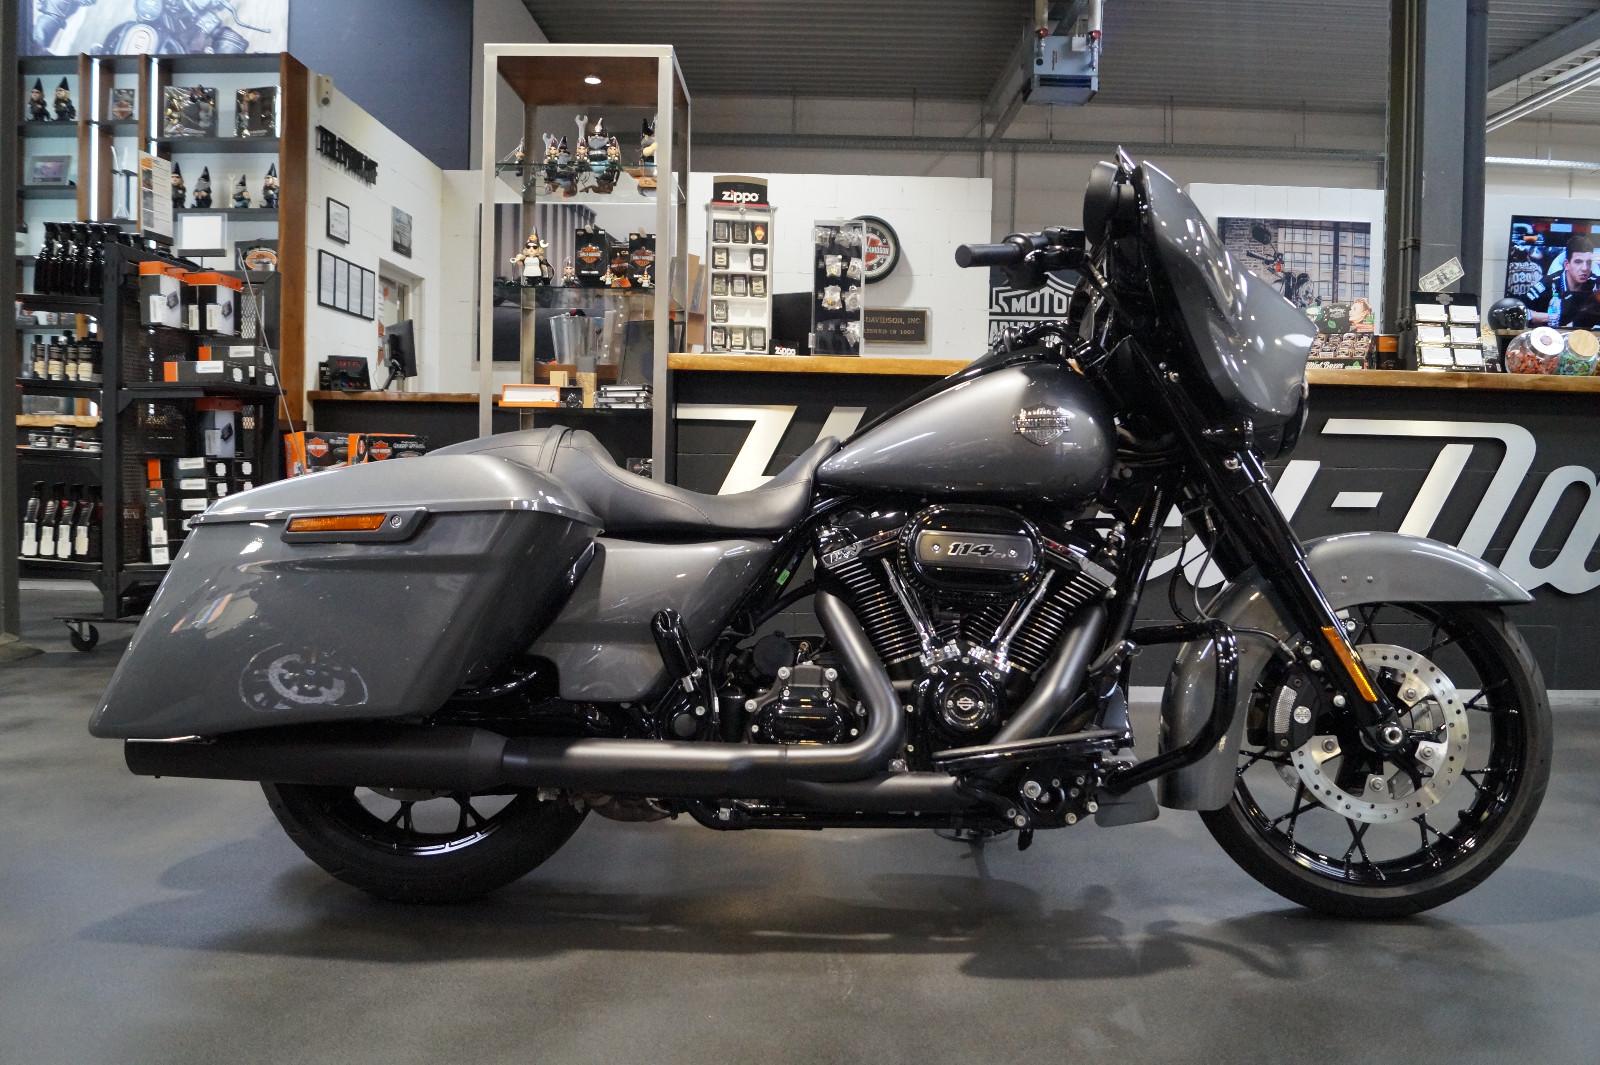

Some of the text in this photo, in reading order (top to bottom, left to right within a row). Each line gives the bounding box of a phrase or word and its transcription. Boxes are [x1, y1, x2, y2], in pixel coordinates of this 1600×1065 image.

[721, 189, 759, 203] zippo
[1011, 286, 1072, 314] MOTO
[947, 541, 996, 557] 114
